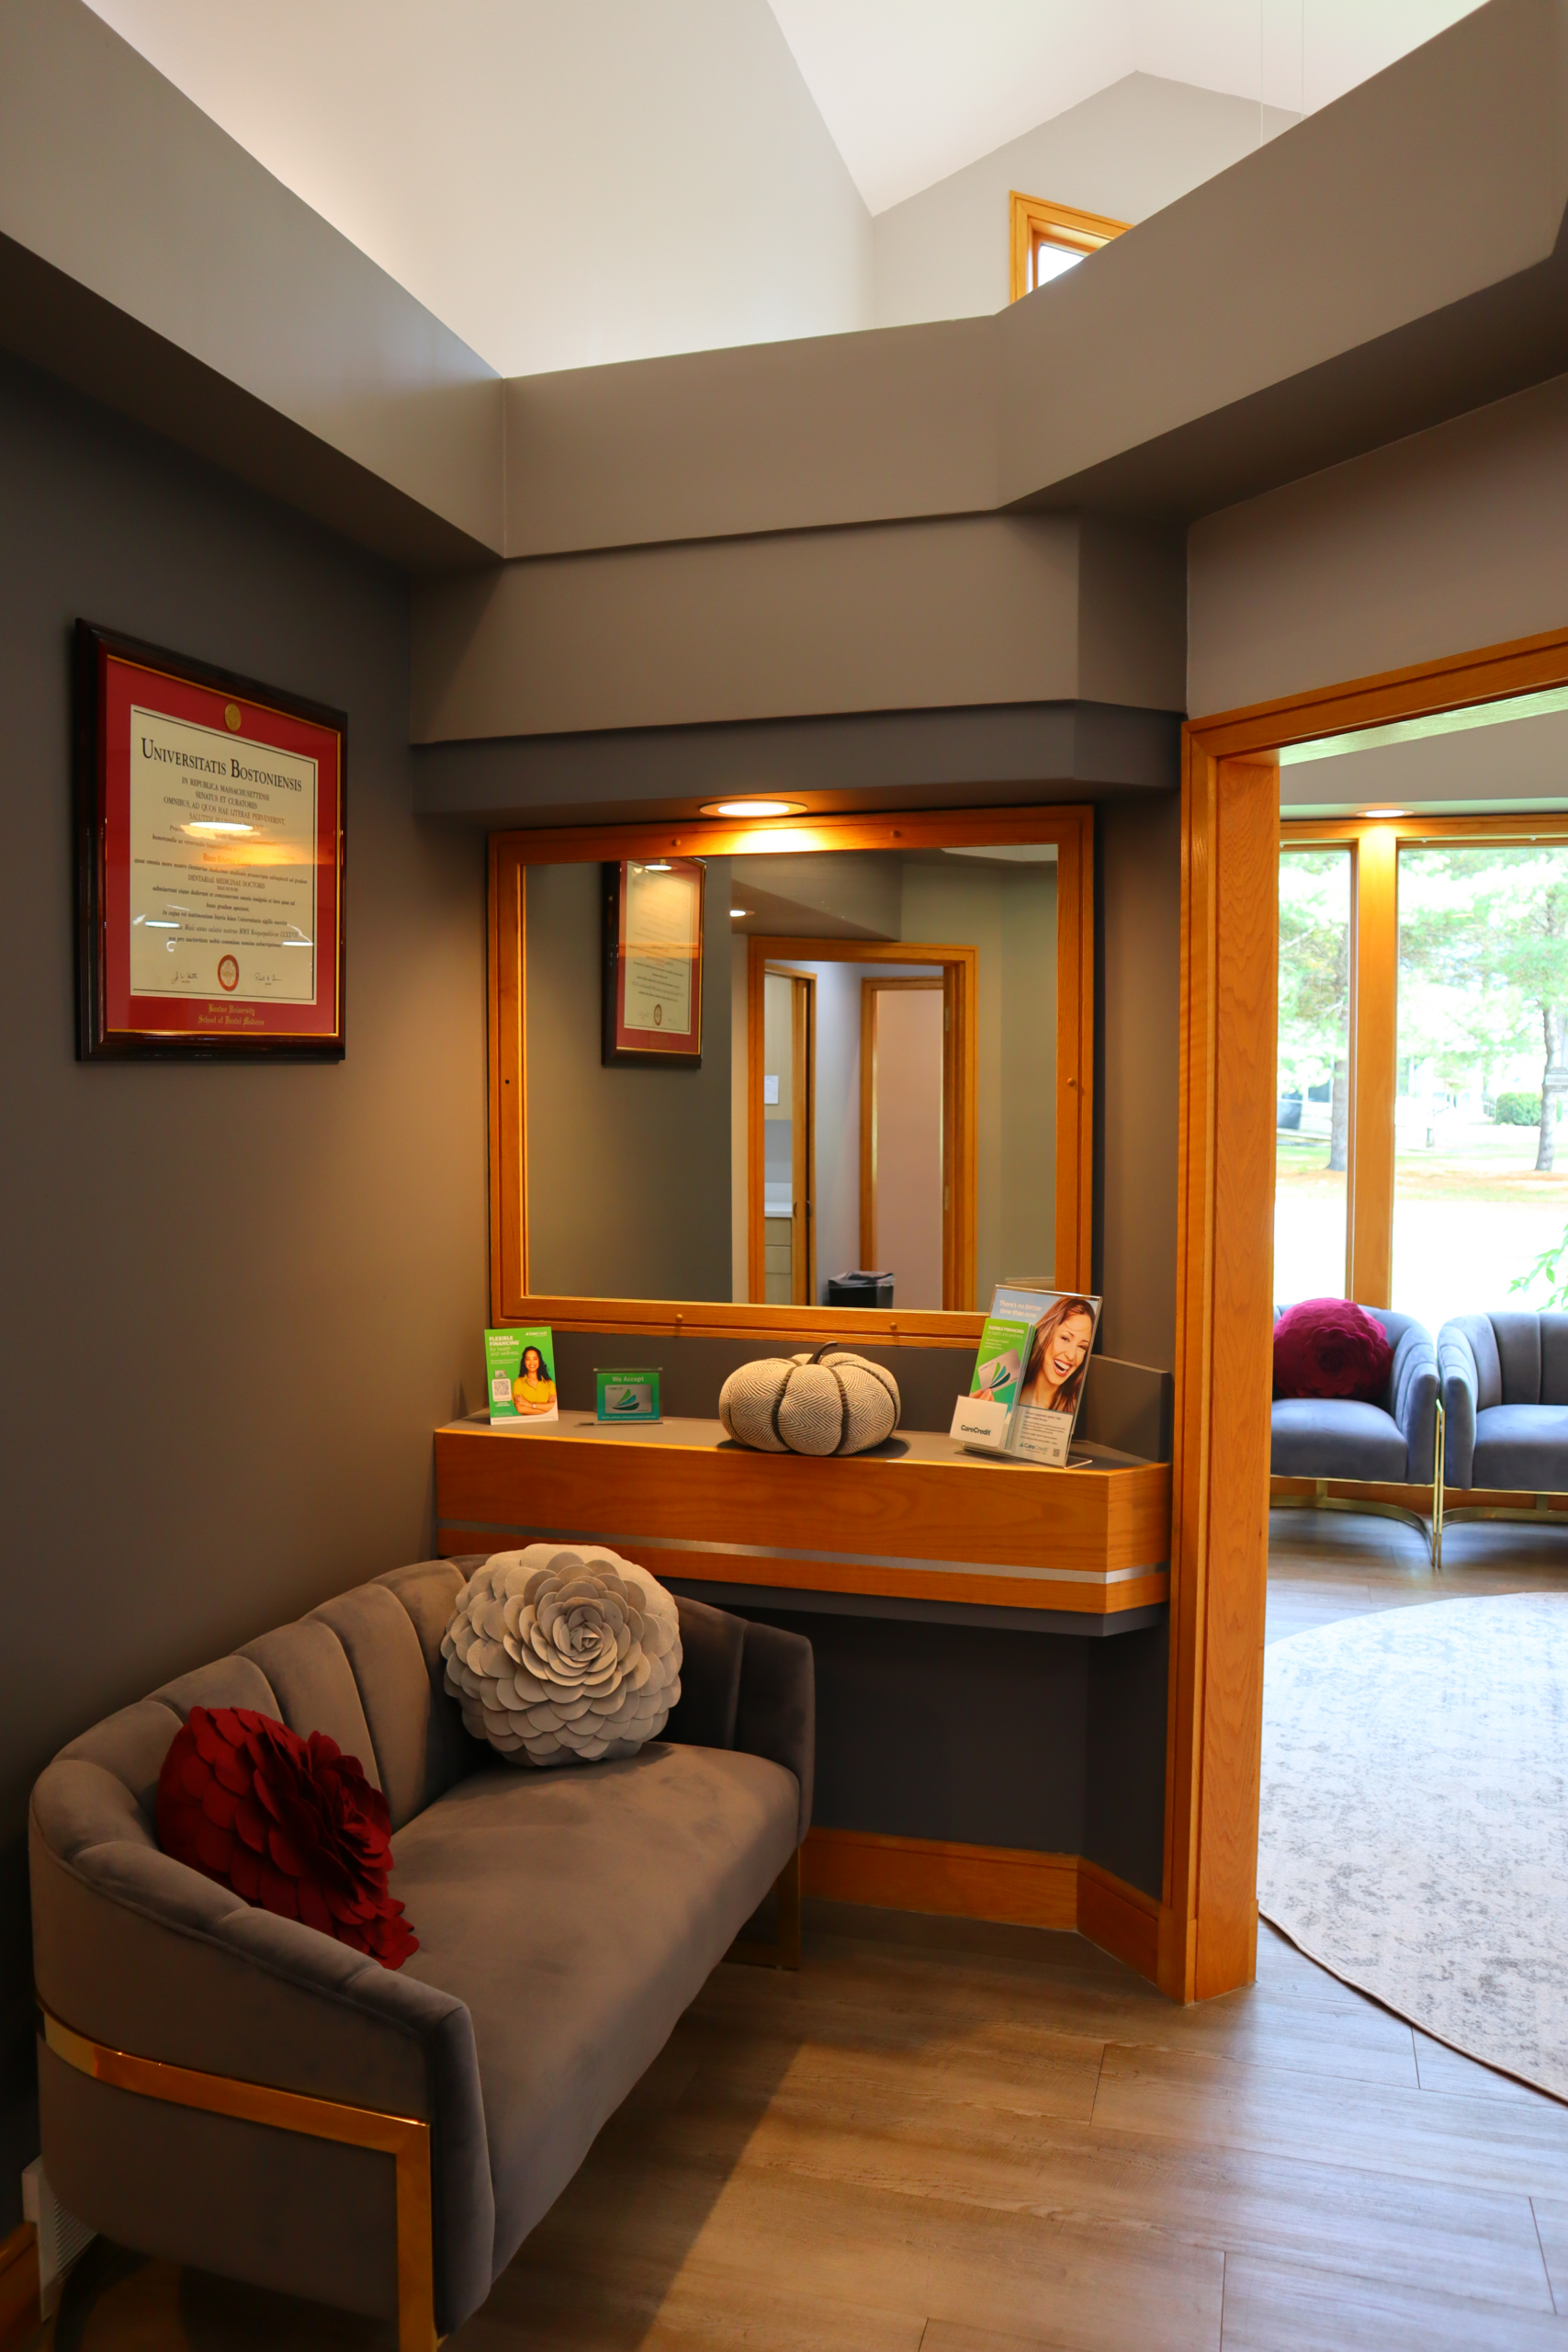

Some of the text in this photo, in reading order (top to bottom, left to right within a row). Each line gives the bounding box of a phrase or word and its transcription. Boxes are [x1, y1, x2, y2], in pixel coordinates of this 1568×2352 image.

[141, 737, 302, 792] UNIVERSITATIS BOSTONIENSIS
[182, 776, 270, 801] IN REPUBLICA MASSACHUSETTENSI
[195, 791, 257, 809] SENATUS ET CURATORES
[192, 801, 200, 809] AD
[201, 803, 217, 812] QUOS
[218, 807, 229, 815] HAE
[230, 808, 251, 819] LITERAE
[187, 874, 265, 888] DENTARIAE MEDICINAE DOCTORIS
[197, 1014, 217, 1023] School
[224, 1015, 242, 1025] Dental
[999, 1299, 1017, 1308] There's
[1025, 1303, 1042, 1311] better
[960, 1424, 991, 1436] CareCredit
